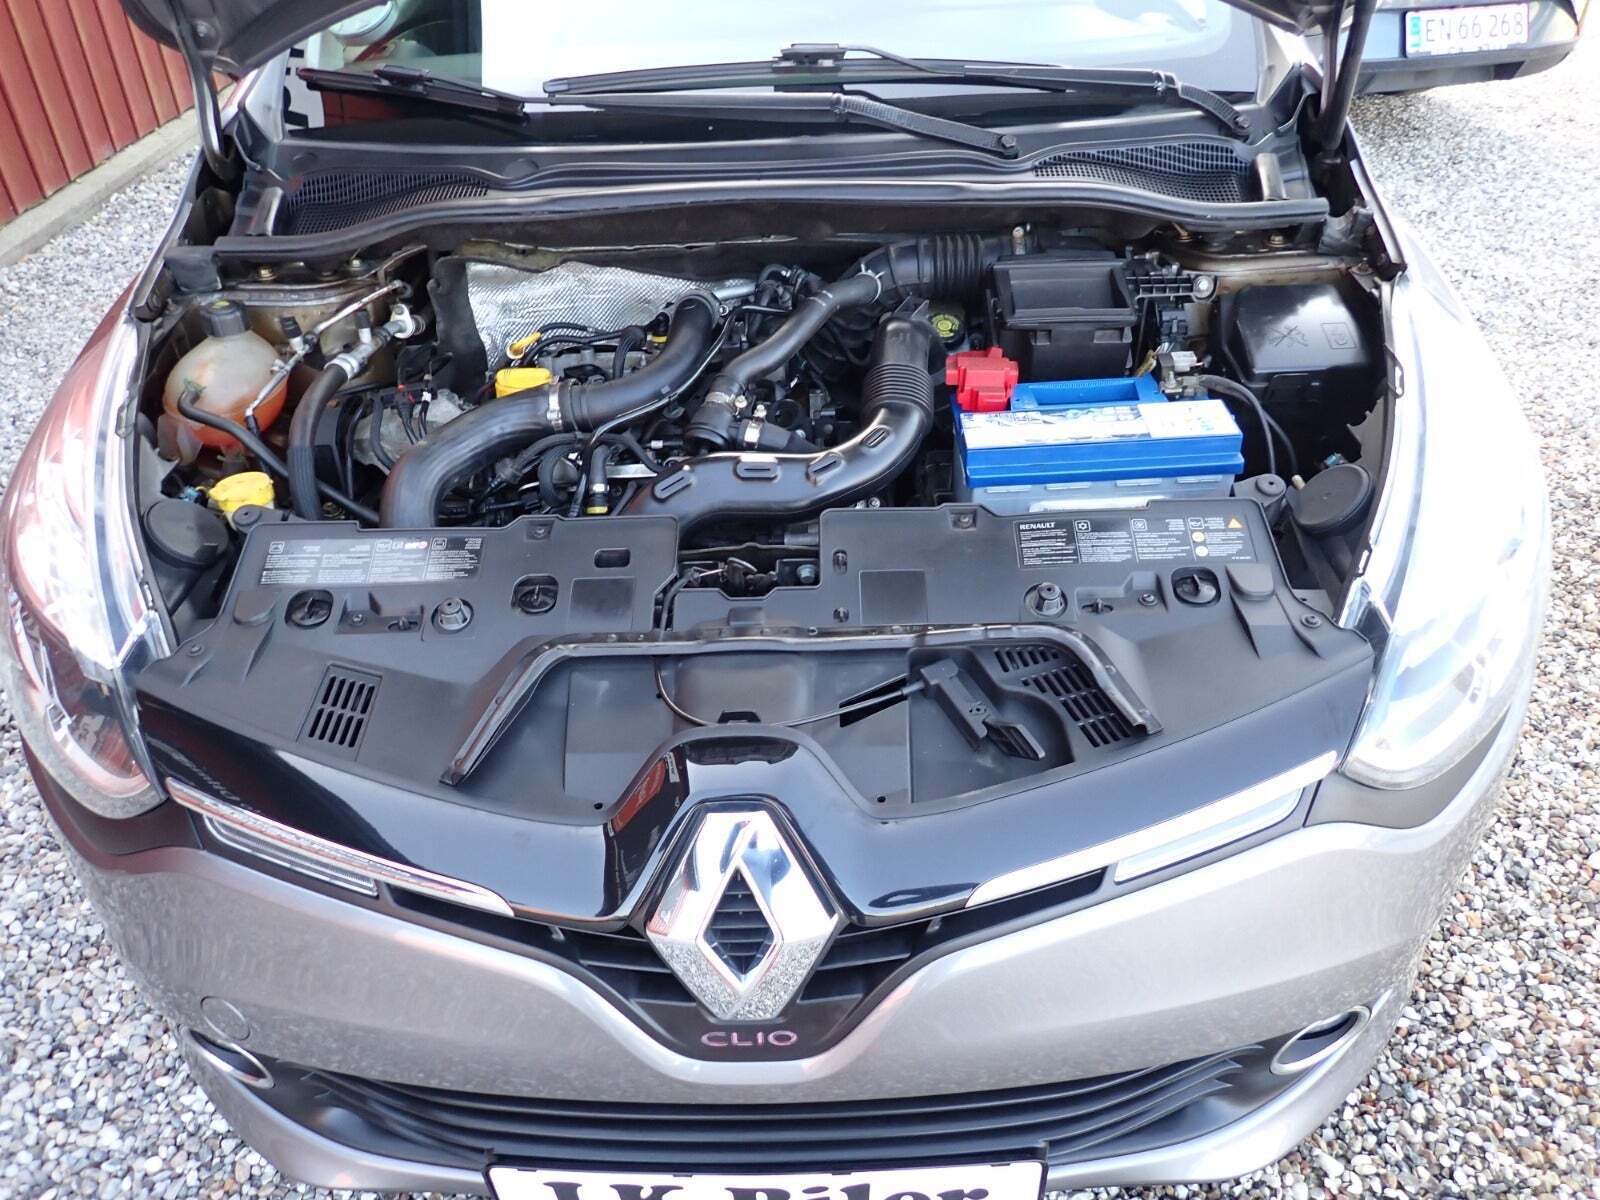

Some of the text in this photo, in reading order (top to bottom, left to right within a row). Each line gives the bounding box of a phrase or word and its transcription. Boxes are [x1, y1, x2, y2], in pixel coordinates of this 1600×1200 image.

[1425, 12, 1524, 42] EN 66 268
[1019, 521, 1055, 530] RENAULT
[700, 1030, 798, 1046] CLIO
